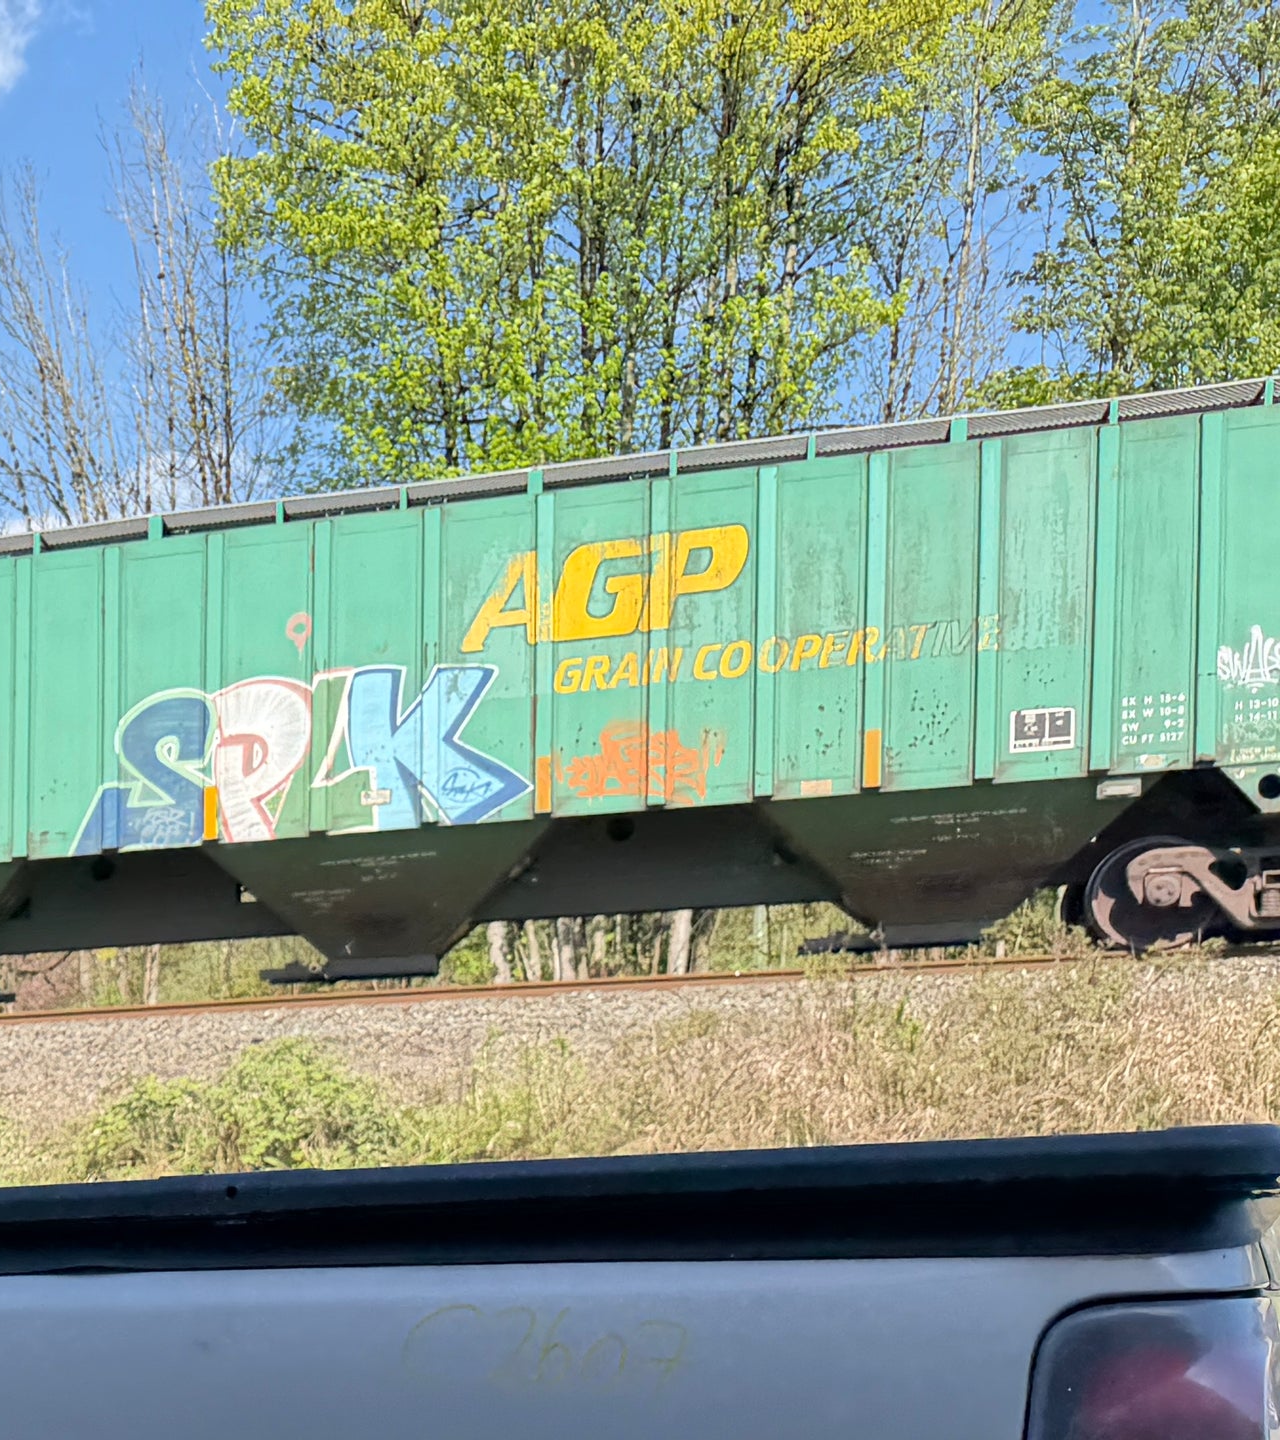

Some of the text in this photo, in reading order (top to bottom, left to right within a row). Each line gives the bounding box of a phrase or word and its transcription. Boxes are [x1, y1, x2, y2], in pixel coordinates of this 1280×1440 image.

[460, 524, 750, 653] AGP
[553, 646, 683, 694] GRAIN
[1144, 695, 1152, 705] H
[1142, 708, 1154, 718] W
[1234, 701, 1243, 711] H
[1234, 713, 1243, 723] H
[1122, 735, 1137, 745] CU
